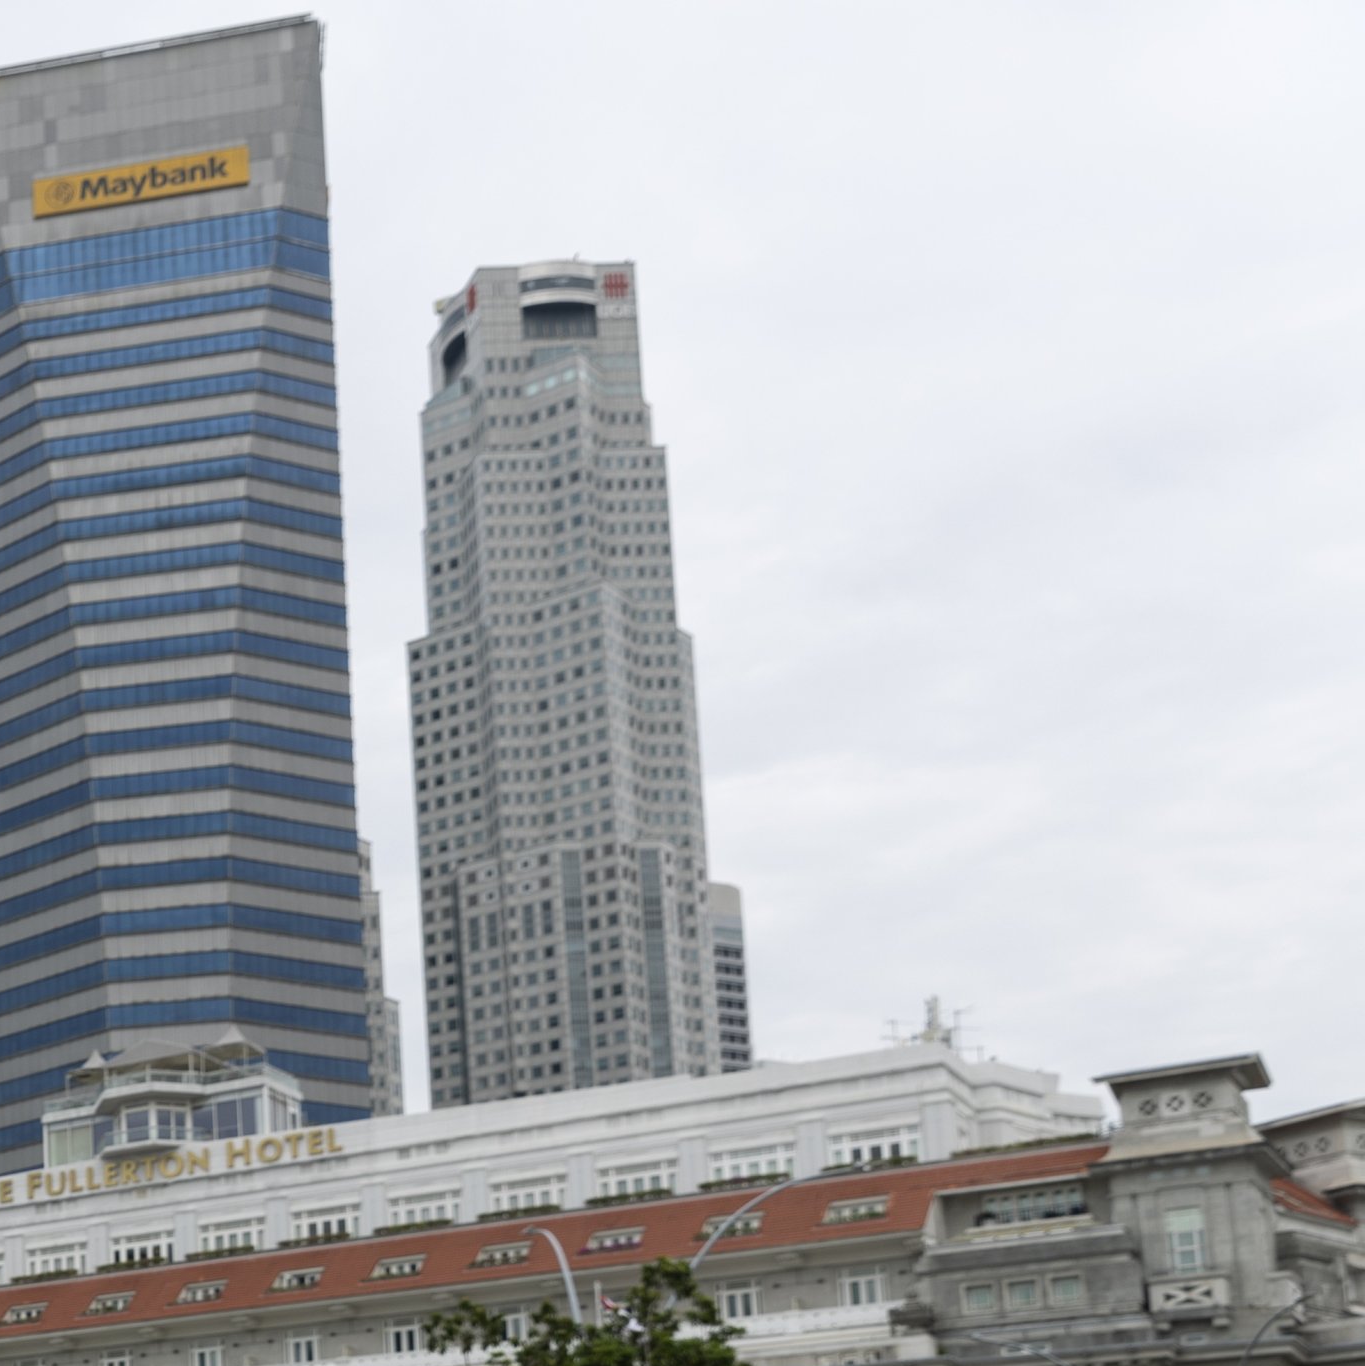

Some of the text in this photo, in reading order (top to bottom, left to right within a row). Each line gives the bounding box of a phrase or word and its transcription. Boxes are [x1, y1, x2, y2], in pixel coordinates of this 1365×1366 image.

[79, 156, 228, 202] Maybank
[26, 1150, 211, 1200] FULLERTON
[225, 1127, 344, 1170] HOTEL
